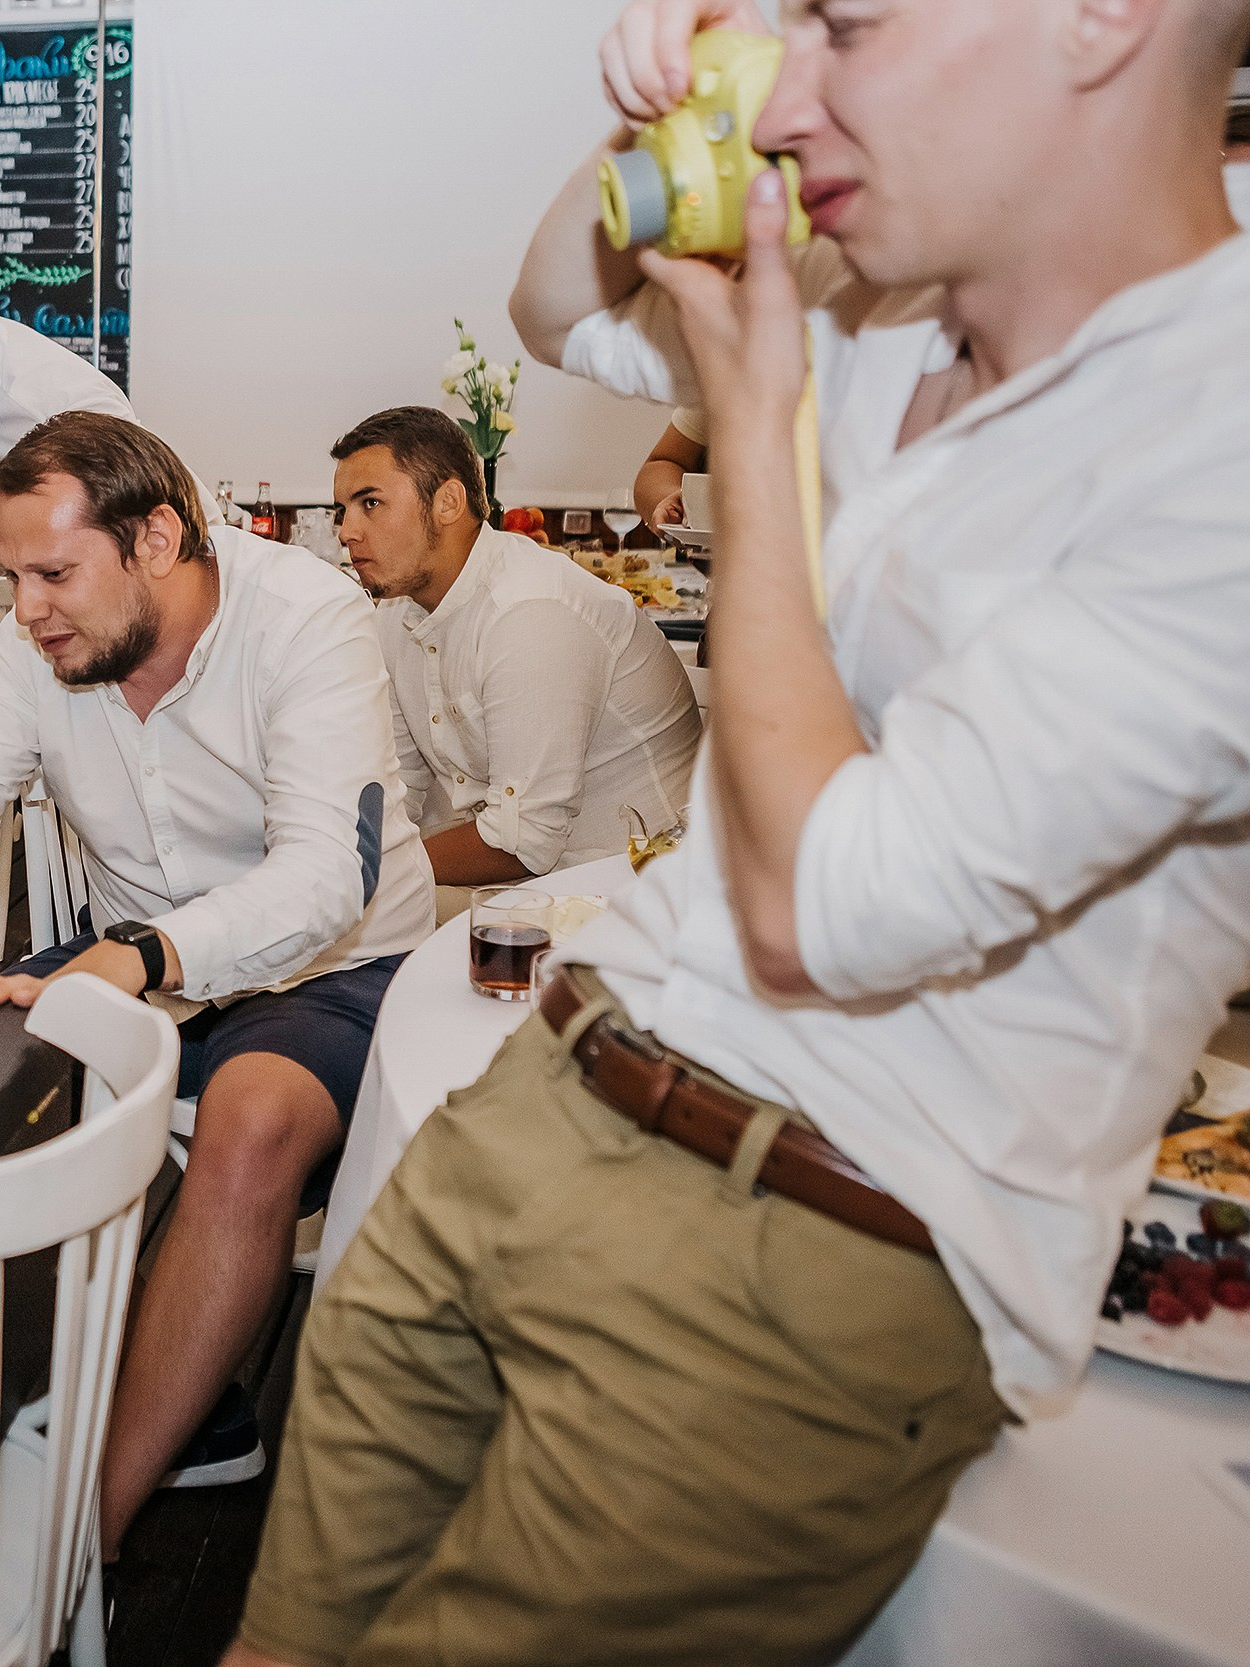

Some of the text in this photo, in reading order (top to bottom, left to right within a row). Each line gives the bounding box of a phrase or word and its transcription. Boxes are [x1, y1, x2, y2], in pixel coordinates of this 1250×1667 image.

[74, 78, 97, 102] 25
[75, 103, 97, 127] 20
[74, 128, 96, 153] 25
[74, 153, 95, 178] 27
[75, 179, 95, 204] 27
[75, 204, 95, 229] 25
[74, 229, 95, 254] 25
